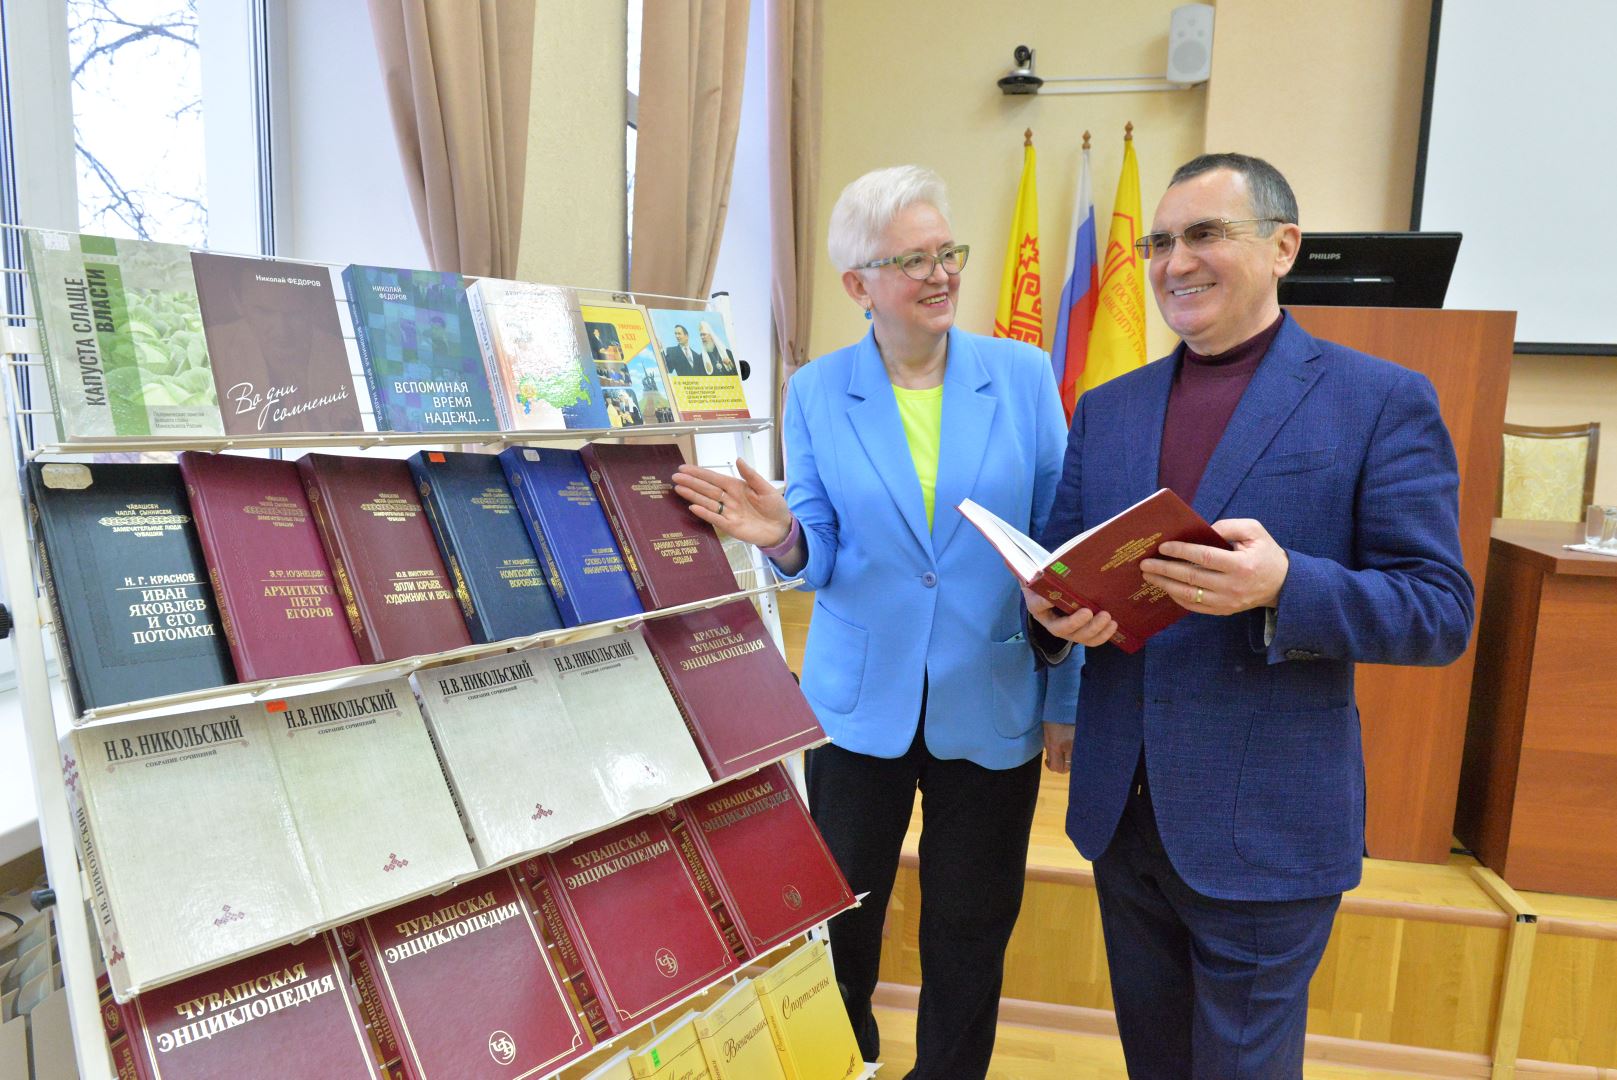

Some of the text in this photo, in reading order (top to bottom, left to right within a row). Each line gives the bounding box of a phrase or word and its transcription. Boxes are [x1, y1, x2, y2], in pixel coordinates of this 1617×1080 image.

[255, 274, 321, 287] Николай ФЕДОРОВ
[372, 285, 402, 293] НИКОЛАЙ
[86, 268, 115, 333] ВЛАСТИ
[64, 277, 106, 406] КАПУСТА СЛАЩЕ
[273, 384, 349, 422] сомнений
[394, 381, 469, 394] ВСПОМИНАЯ
[433, 396, 472, 408] ВРЕМЯ
[227, 382, 298, 430] Во дни
[424, 411, 490, 426] НАДЕЖД...
[124, 573, 196, 587] Н. Г. КРАСНОВ
[141, 587, 188, 602] ИВАН
[384, 591, 428, 605] ХУДОЖНИК
[427, 591, 435, 601] И
[393, 581, 416, 592] ЭЛЛИ
[129, 599, 207, 617] ЯКОВЛЕВ
[286, 607, 334, 619] ЕГОРОВ
[290, 596, 321, 607] ПЕТР
[132, 624, 216, 645] ПОТОМКИ
[148, 613, 196, 629] И ЕГО
[693, 625, 731, 642] КРАТКАЯ
[553, 639, 635, 673] Н.В. НИКОЛЬСКИЙ
[680, 638, 765, 671] ЭНЦИКЛОПЕДИЯ
[690, 633, 744, 654] ЧУВАШСКАЯ
[438, 659, 534, 695] Н.В. НИКОЛЬСКИЙ
[283, 689, 398, 729] Н.В. НИКОЛЬСКИЙ
[317, 719, 377, 735] СОБРАНИЕ СОЧИНЕНИЙ
[104, 716, 244, 761] Н.В. НИКОЛЬСКИЙ
[145, 750, 217, 768] СОБРАНИЕ СОЧИНЕНИЙ
[702, 788, 792, 832] ЭНЦИКЛОПЕДИЯ
[707, 781, 774, 814] ЧУВАШСКАЯ
[76, 806, 112, 925] Н.В. НИКОЛЬСКИЙ
[565, 839, 670, 890] ЭНЦИКЛОПЕДИЯ
[572, 831, 651, 869] ЧУВАШСКАЯ
[681, 830, 716, 898] ЭНЦИКЛОПЕДИЯ
[681, 842, 708, 892] ЧУВАШСКАЯ
[384, 901, 520, 964] ЭНЦИКЛОПЕДИЯ
[395, 891, 497, 938] ЧУВАШСКАЯ
[542, 902, 568, 960] ЧУВАШСКАЯ
[543, 888, 579, 966] ЭНЦИКЛОПЕДИЯ
[174, 962, 308, 1021] ЧУВАШСКАЯ
[356, 976, 384, 1043] ЧУВАШСКАЯ
[359, 960, 397, 1051] ЭНЦИКЛОПЕДИЯ
[782, 977, 829, 1020] Спортсмены
[156, 974, 336, 1053] ЭНЦИКЛОПЕДИЯ
